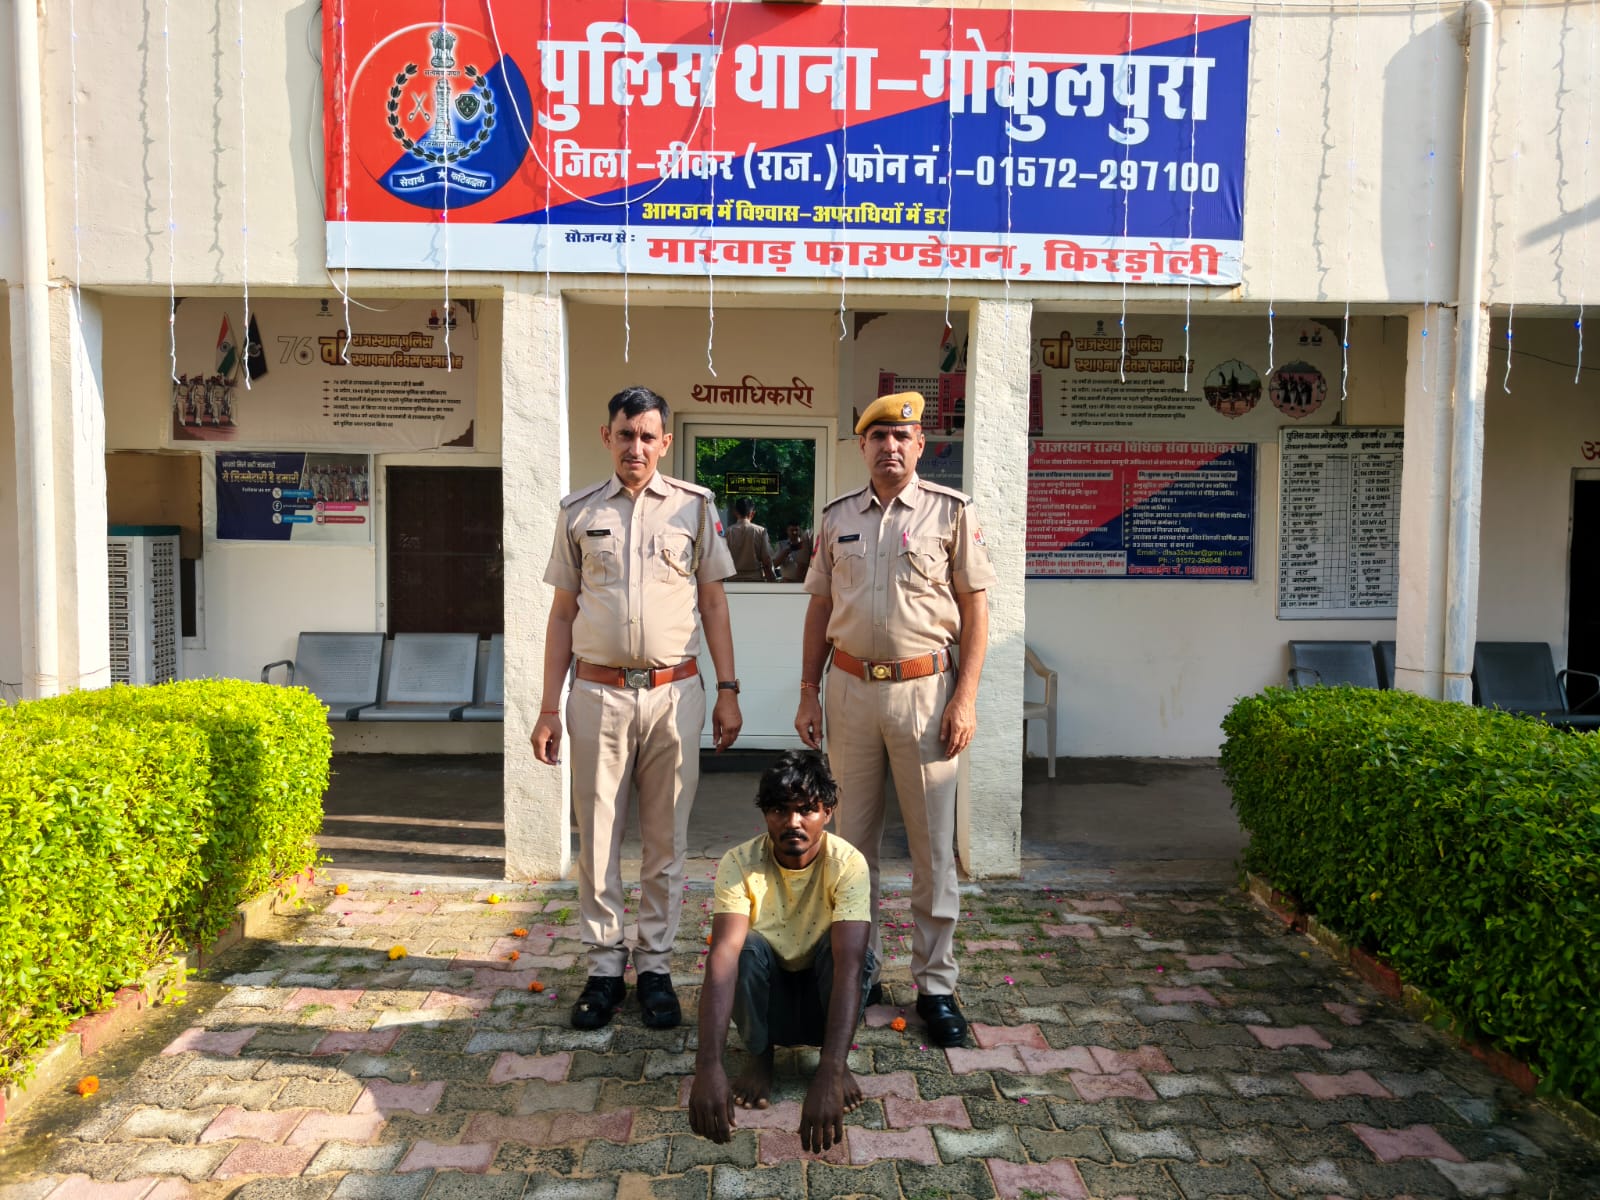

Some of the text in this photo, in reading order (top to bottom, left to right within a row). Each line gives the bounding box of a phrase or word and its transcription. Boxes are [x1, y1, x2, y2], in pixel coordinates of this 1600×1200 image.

[537, 21, 723, 131] पुलिस
[554, 139, 631, 179] जिला
[847, 144, 908, 184] फोन
[913, 145, 947, 185] नं.
[400, 173, 425, 187] सेवार्थ
[642, 202, 712, 222] आमजन
[717, 199, 734, 222] में
[906, 202, 923, 224] में
[924, 209, 946, 225] डर
[565, 230, 612, 243] सौजन्य
[647, 235, 1224, 281] मारवाड़ फाउण्डेशन, किरड़ोली
[351, 334, 402, 349] राजस्थान
[401, 332, 434, 351] पुलिस
[1126, 335, 1164, 356] पुलिस
[351, 353, 392, 368] स्थापना
[393, 351, 423, 368] दिवस
[1075, 357, 1120, 373] स्थापना
[691, 375, 815, 408] थानाधिकारी
[1039, 441, 1092, 455] राजस्थान
[1094, 441, 1122, 455] राज्य
[1190, 441, 1249, 456] प्राधिकरण
